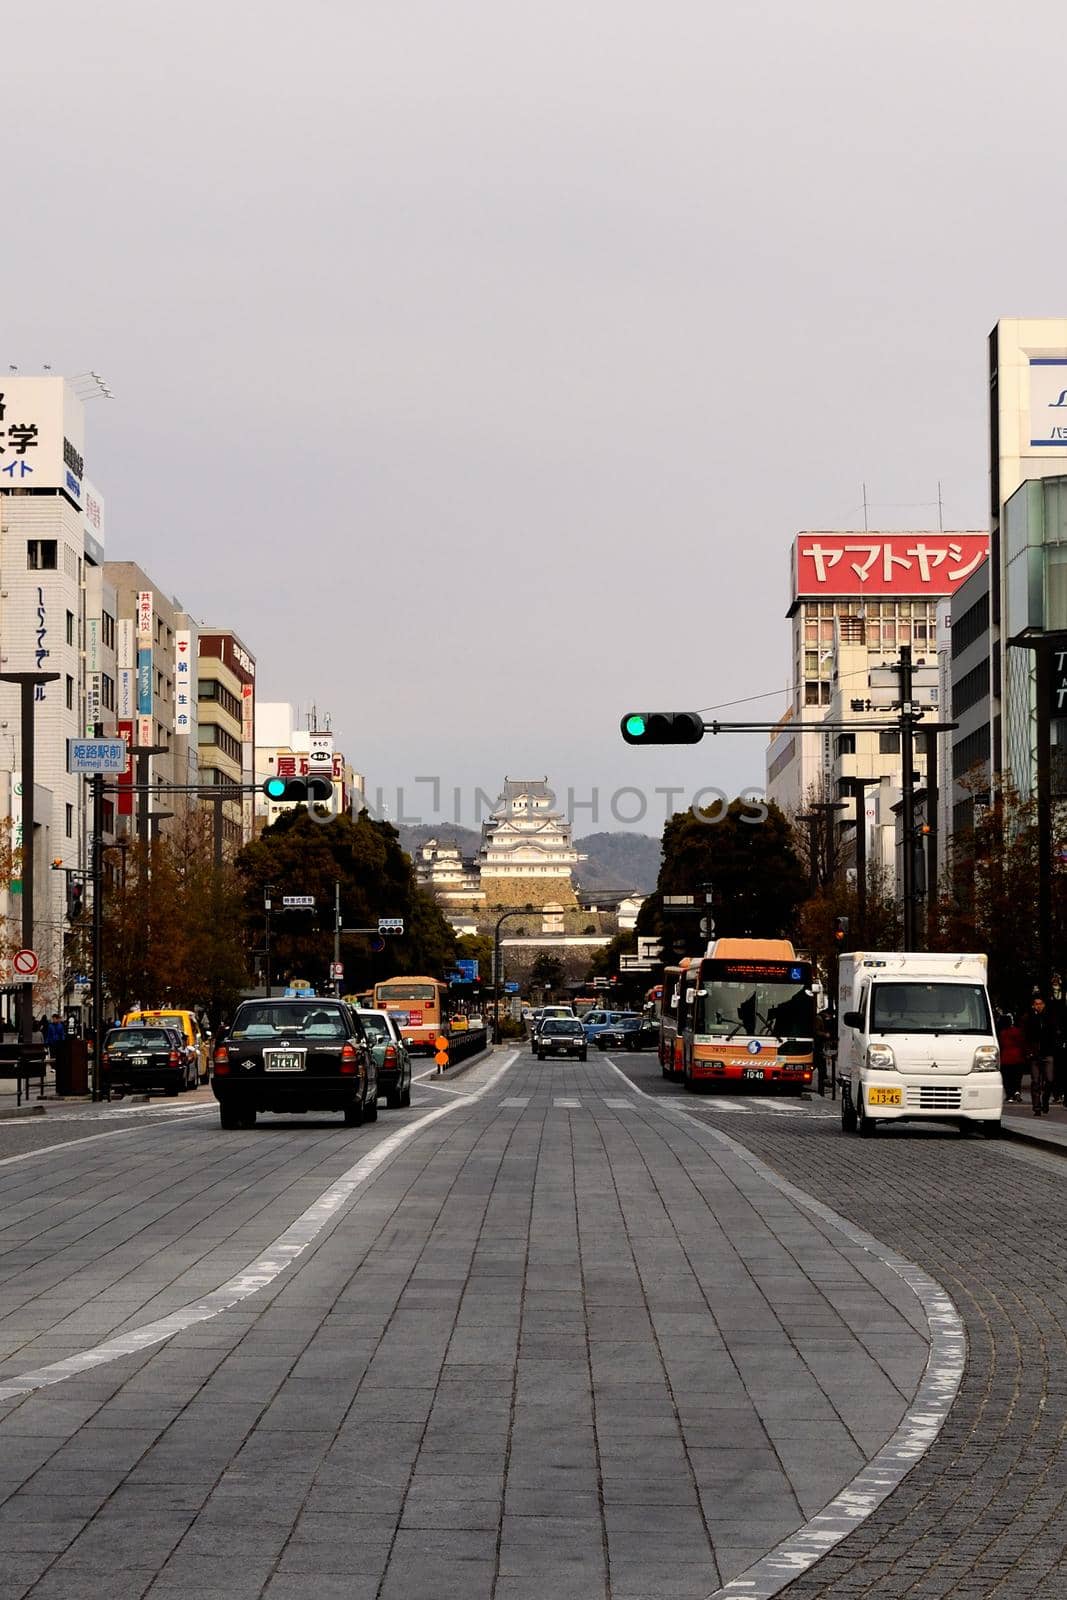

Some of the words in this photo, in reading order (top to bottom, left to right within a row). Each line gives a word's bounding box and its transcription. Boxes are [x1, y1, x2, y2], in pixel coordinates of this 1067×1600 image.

[0, 424, 38, 454] 学
[803, 543, 990, 582] ヤマトヤシ
[140, 593, 151, 632] 共栄火災
[35, 587, 50, 701] しらさぎル
[177, 661, 188, 726] 第一生命
[73, 744, 121, 759] 姫路駅前
[77, 759, 101, 769] Himeji
[104, 759, 120, 768] Sta.
[729, 1059, 777, 1067] Hybrid
[876, 1094, 900, 1104] 13-45
